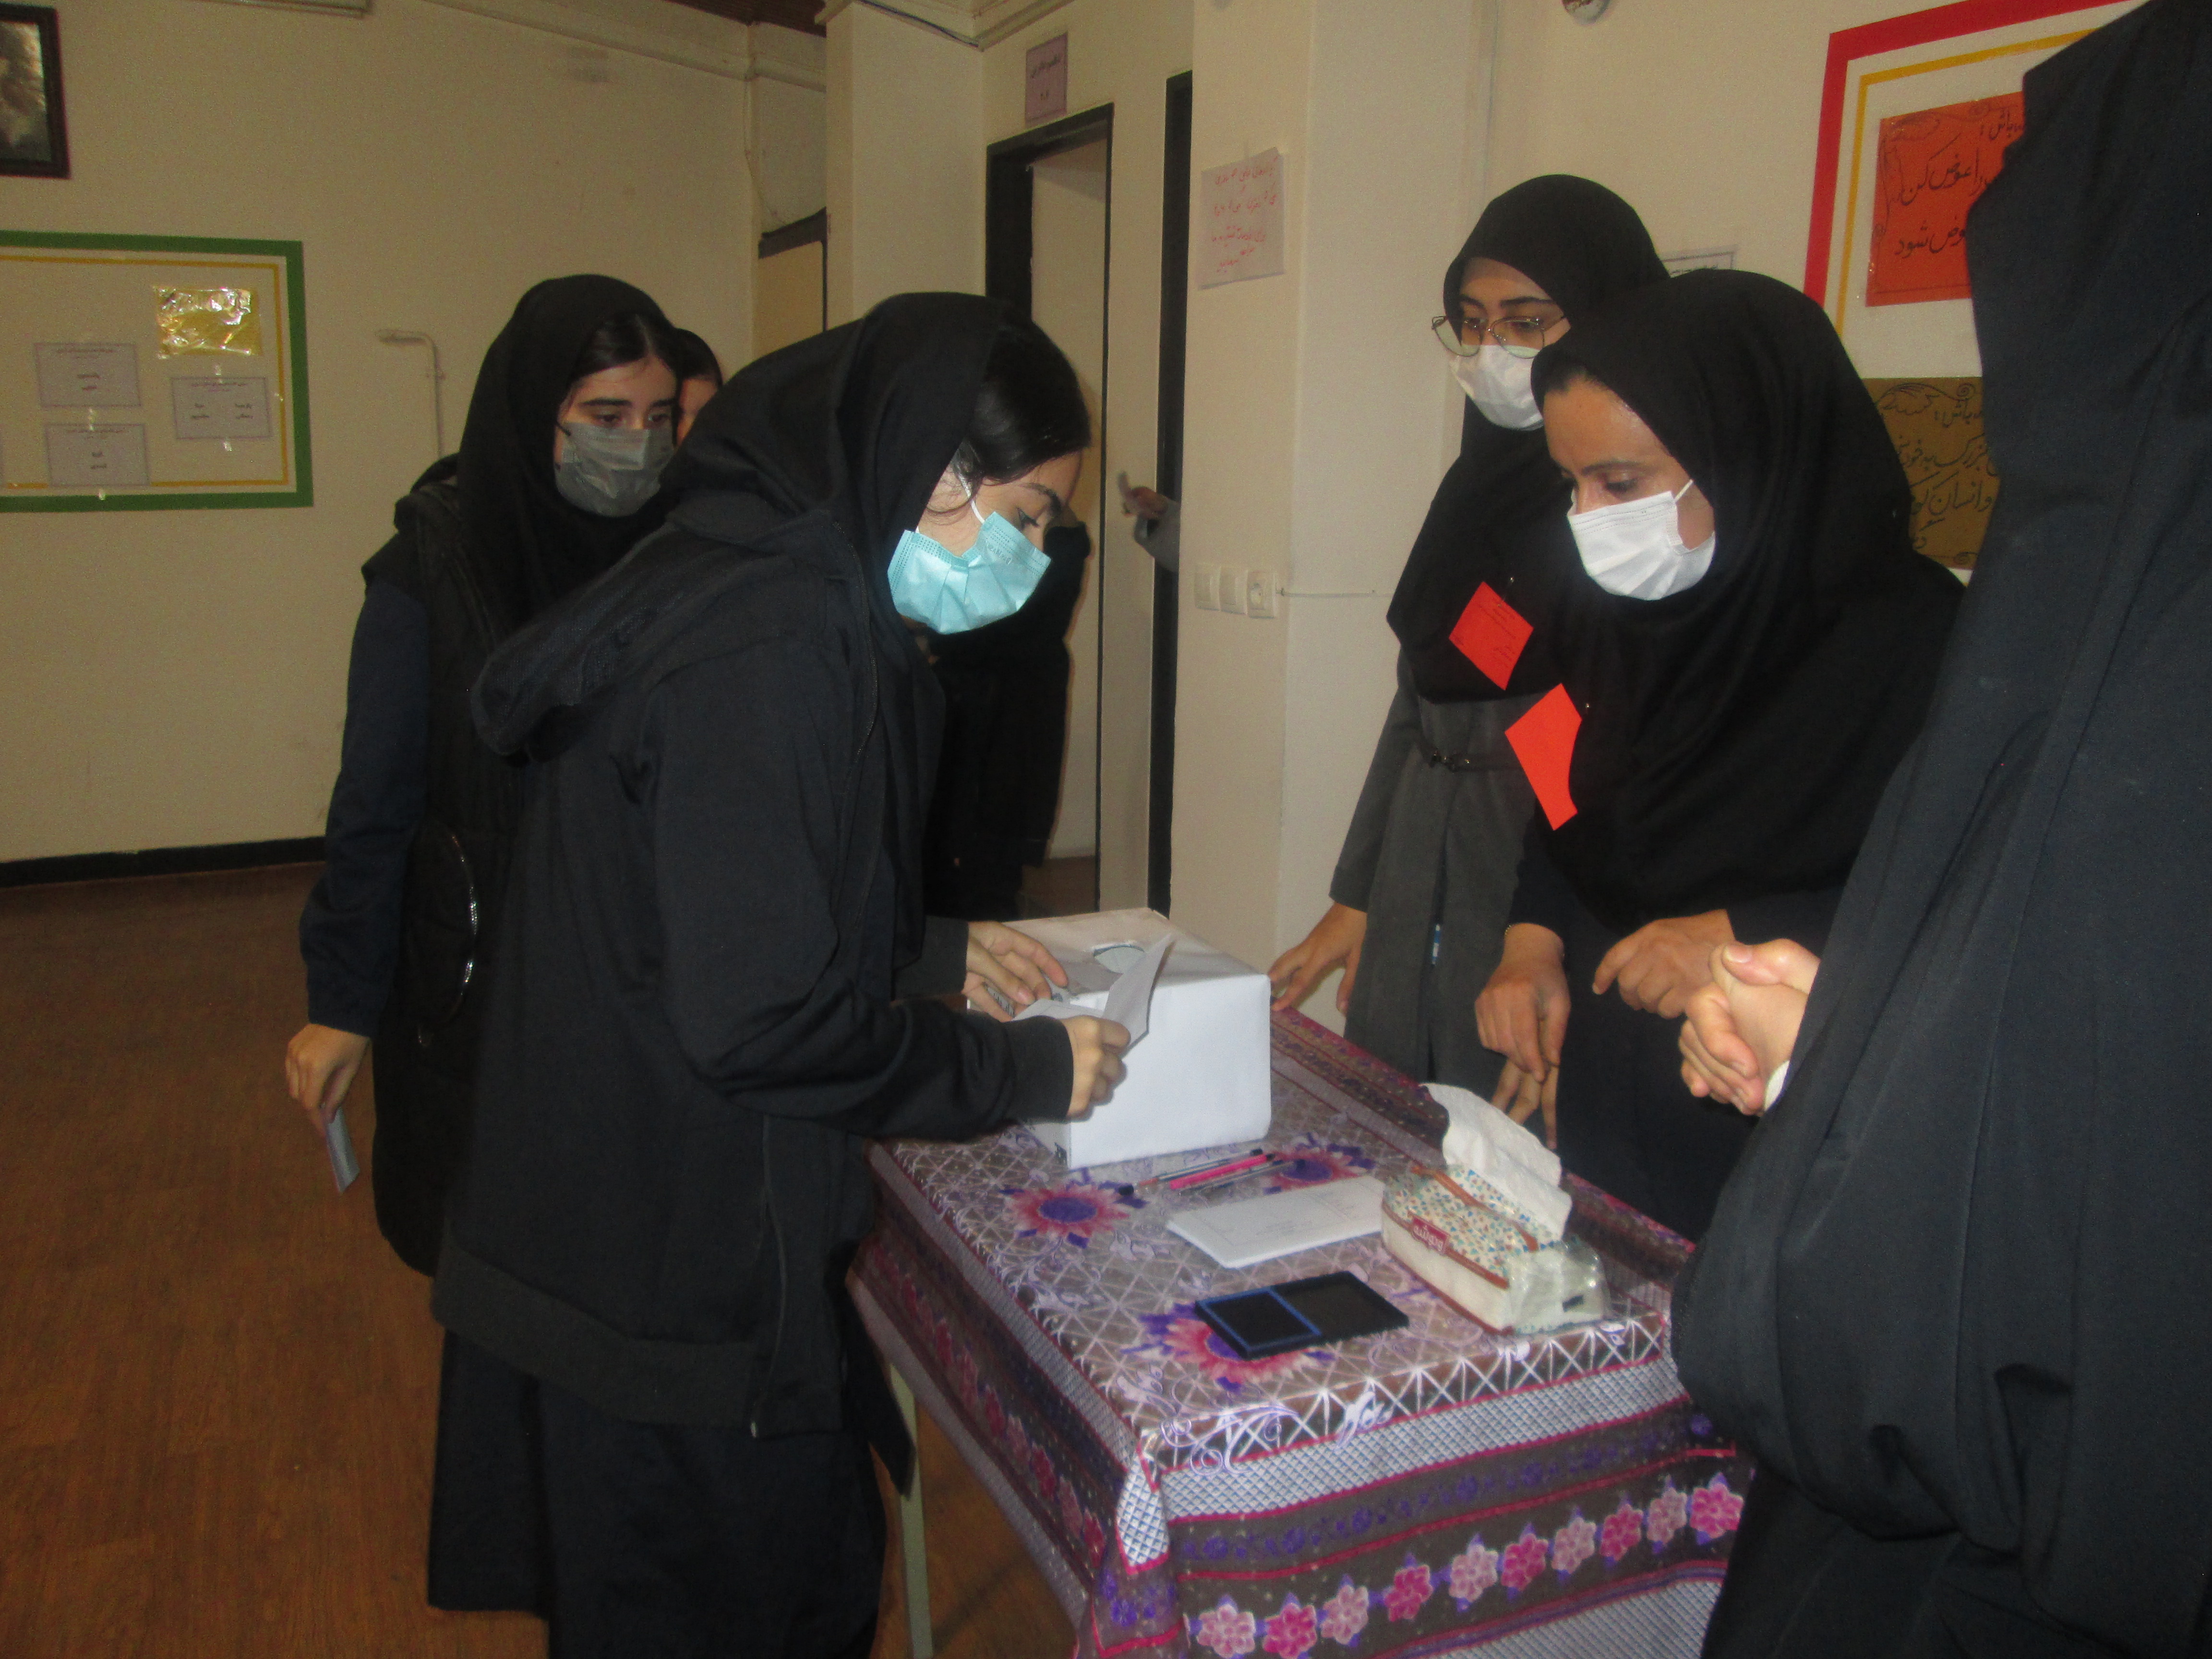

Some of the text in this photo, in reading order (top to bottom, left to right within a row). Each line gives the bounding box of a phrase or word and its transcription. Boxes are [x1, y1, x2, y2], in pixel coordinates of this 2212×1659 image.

[1929, 153, 1972, 190] عوض
[1895, 216, 1967, 259] وض شود
